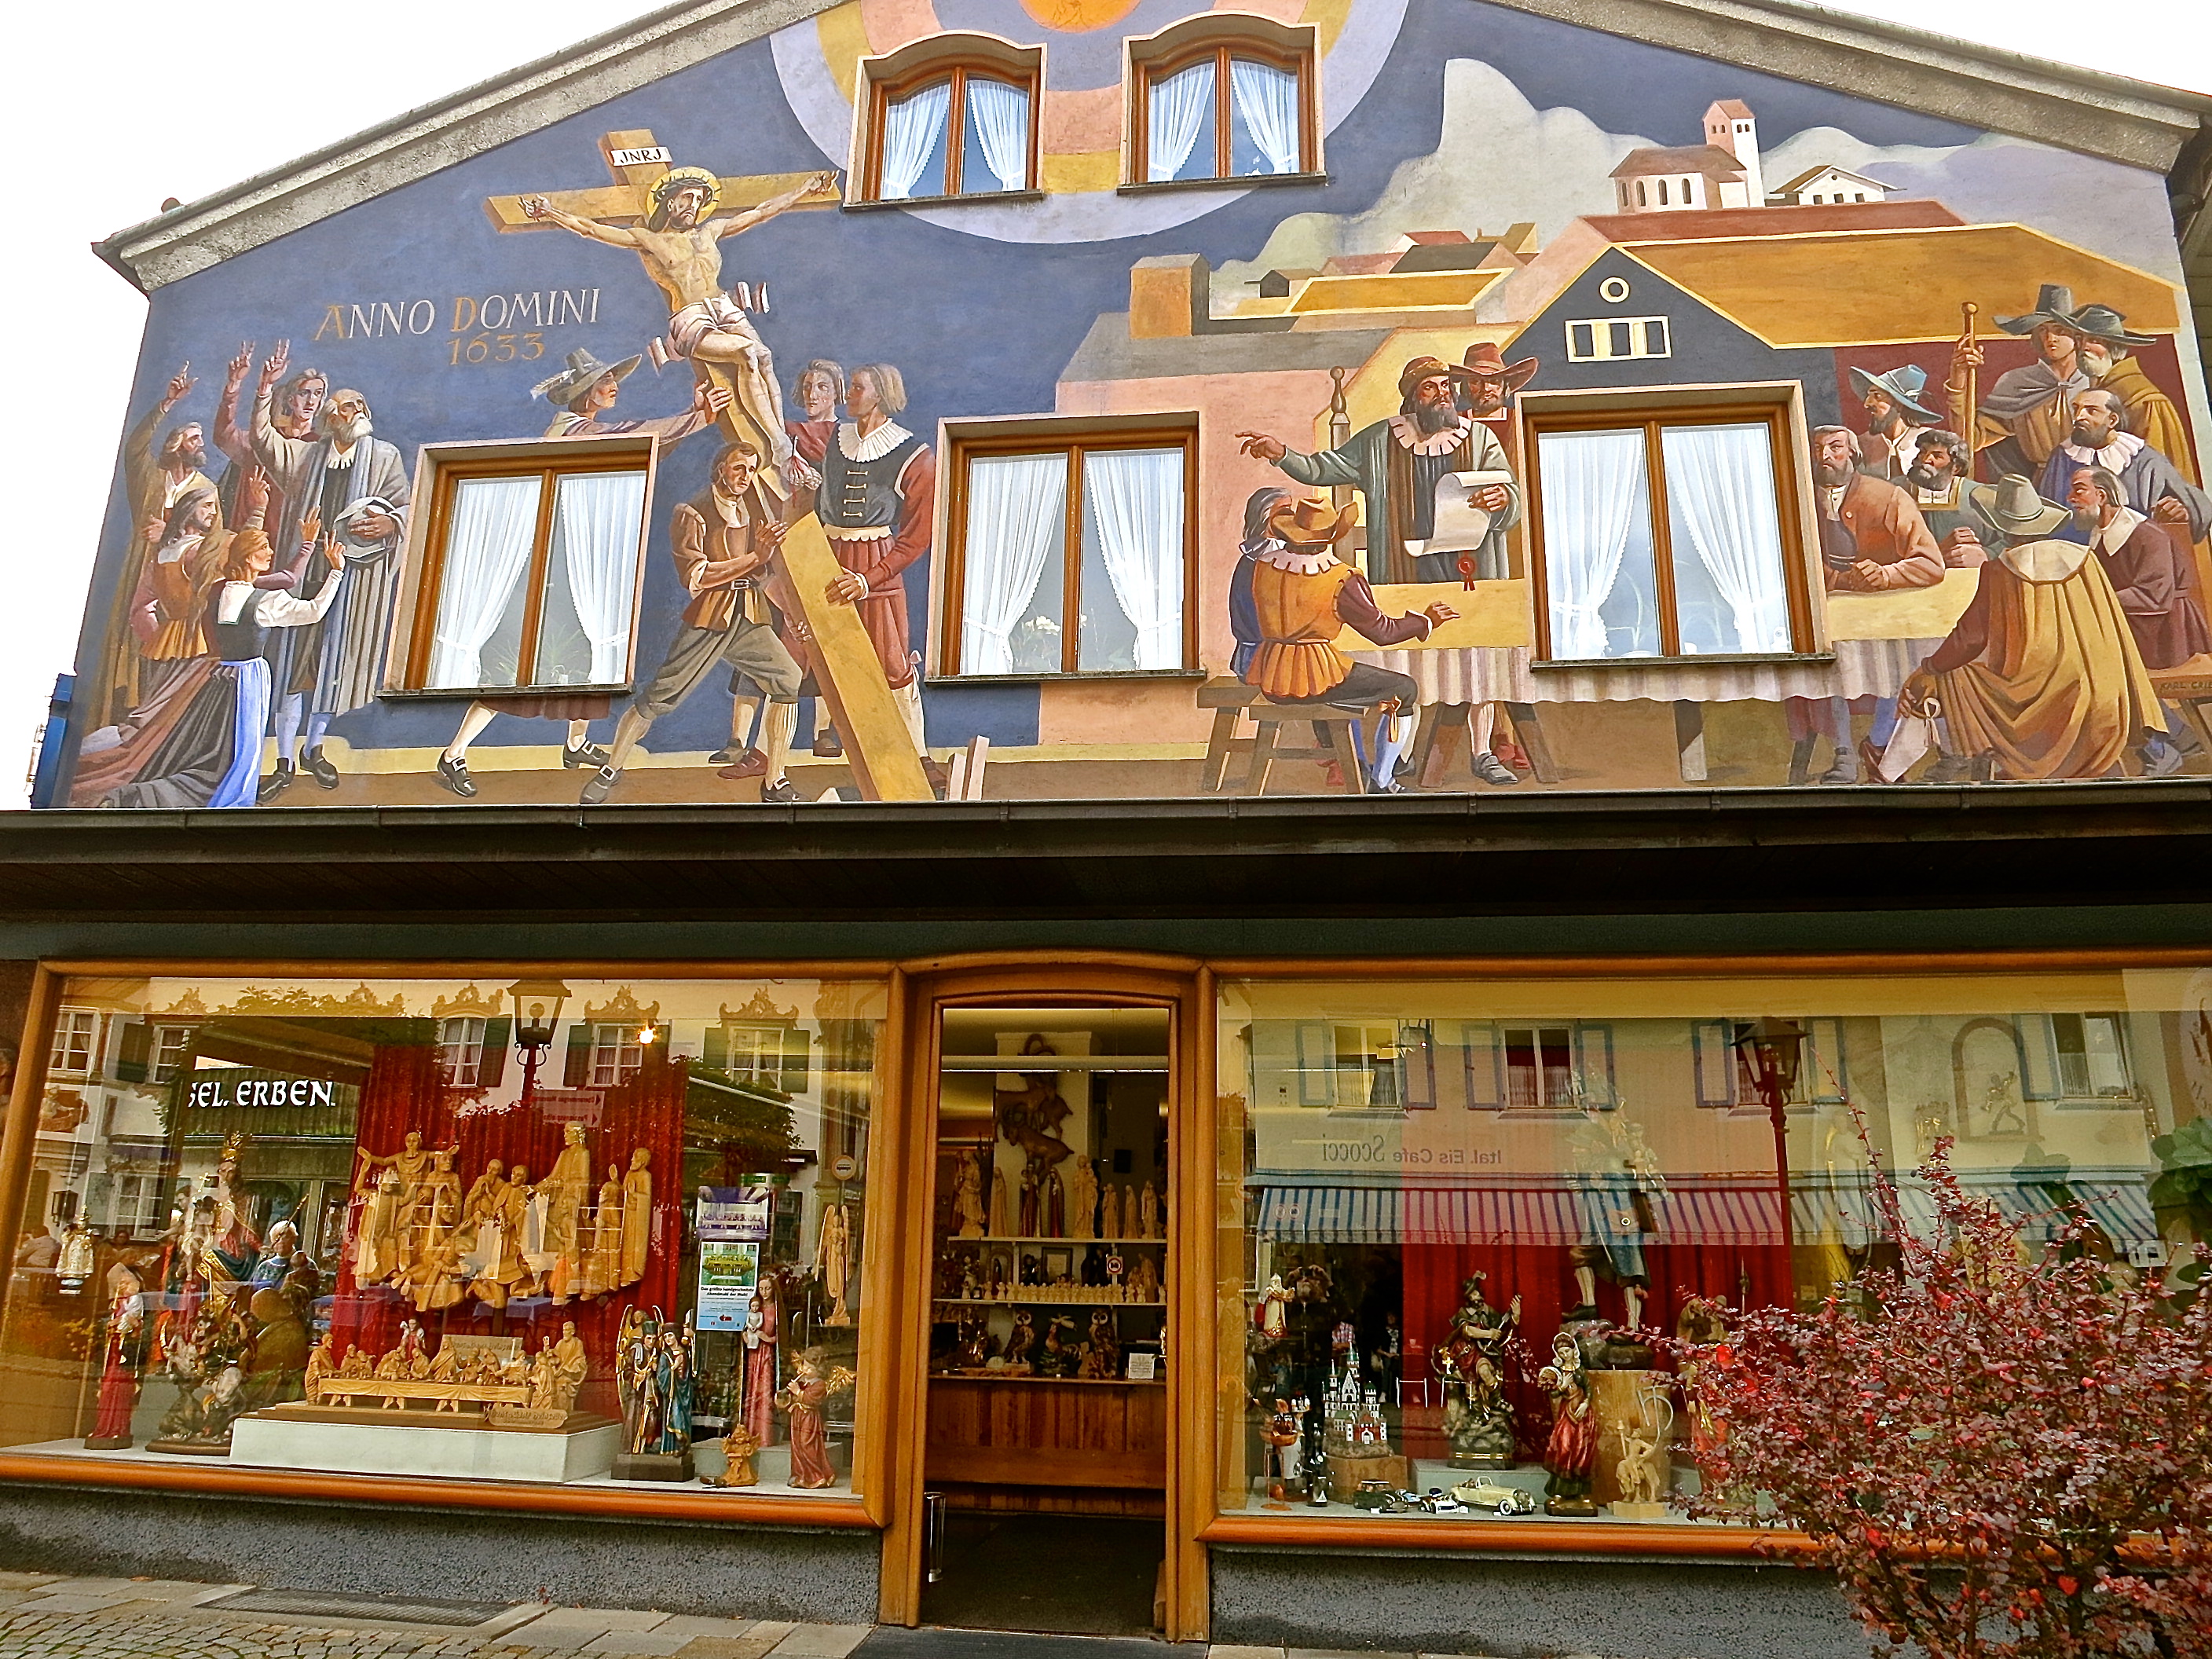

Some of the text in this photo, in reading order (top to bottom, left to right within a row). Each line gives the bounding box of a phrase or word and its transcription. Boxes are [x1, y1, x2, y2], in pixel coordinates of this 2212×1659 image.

[313, 288, 600, 341] ANNO DOMINI
[447, 331, 545, 365] 1633
